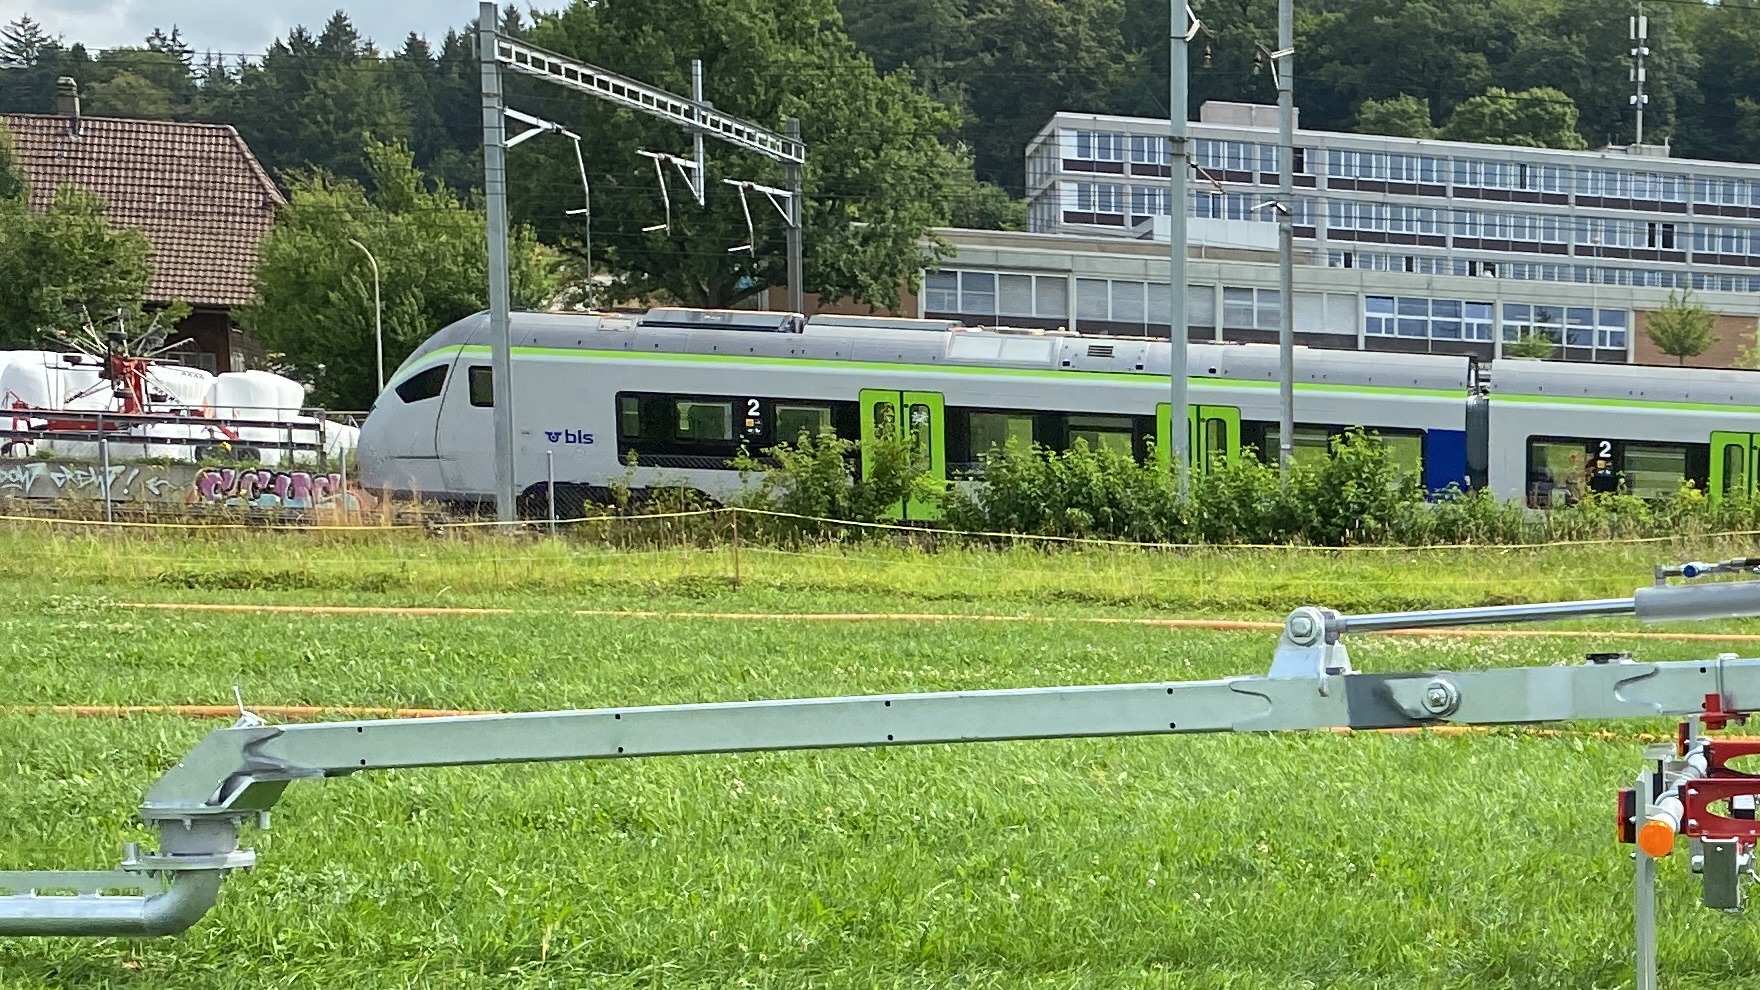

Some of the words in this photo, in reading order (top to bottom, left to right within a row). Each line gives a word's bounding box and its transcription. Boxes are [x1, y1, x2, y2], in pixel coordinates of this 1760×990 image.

[747, 399, 761, 416] 2
[564, 428, 594, 445] bls
[1599, 440, 1612, 458] 2
